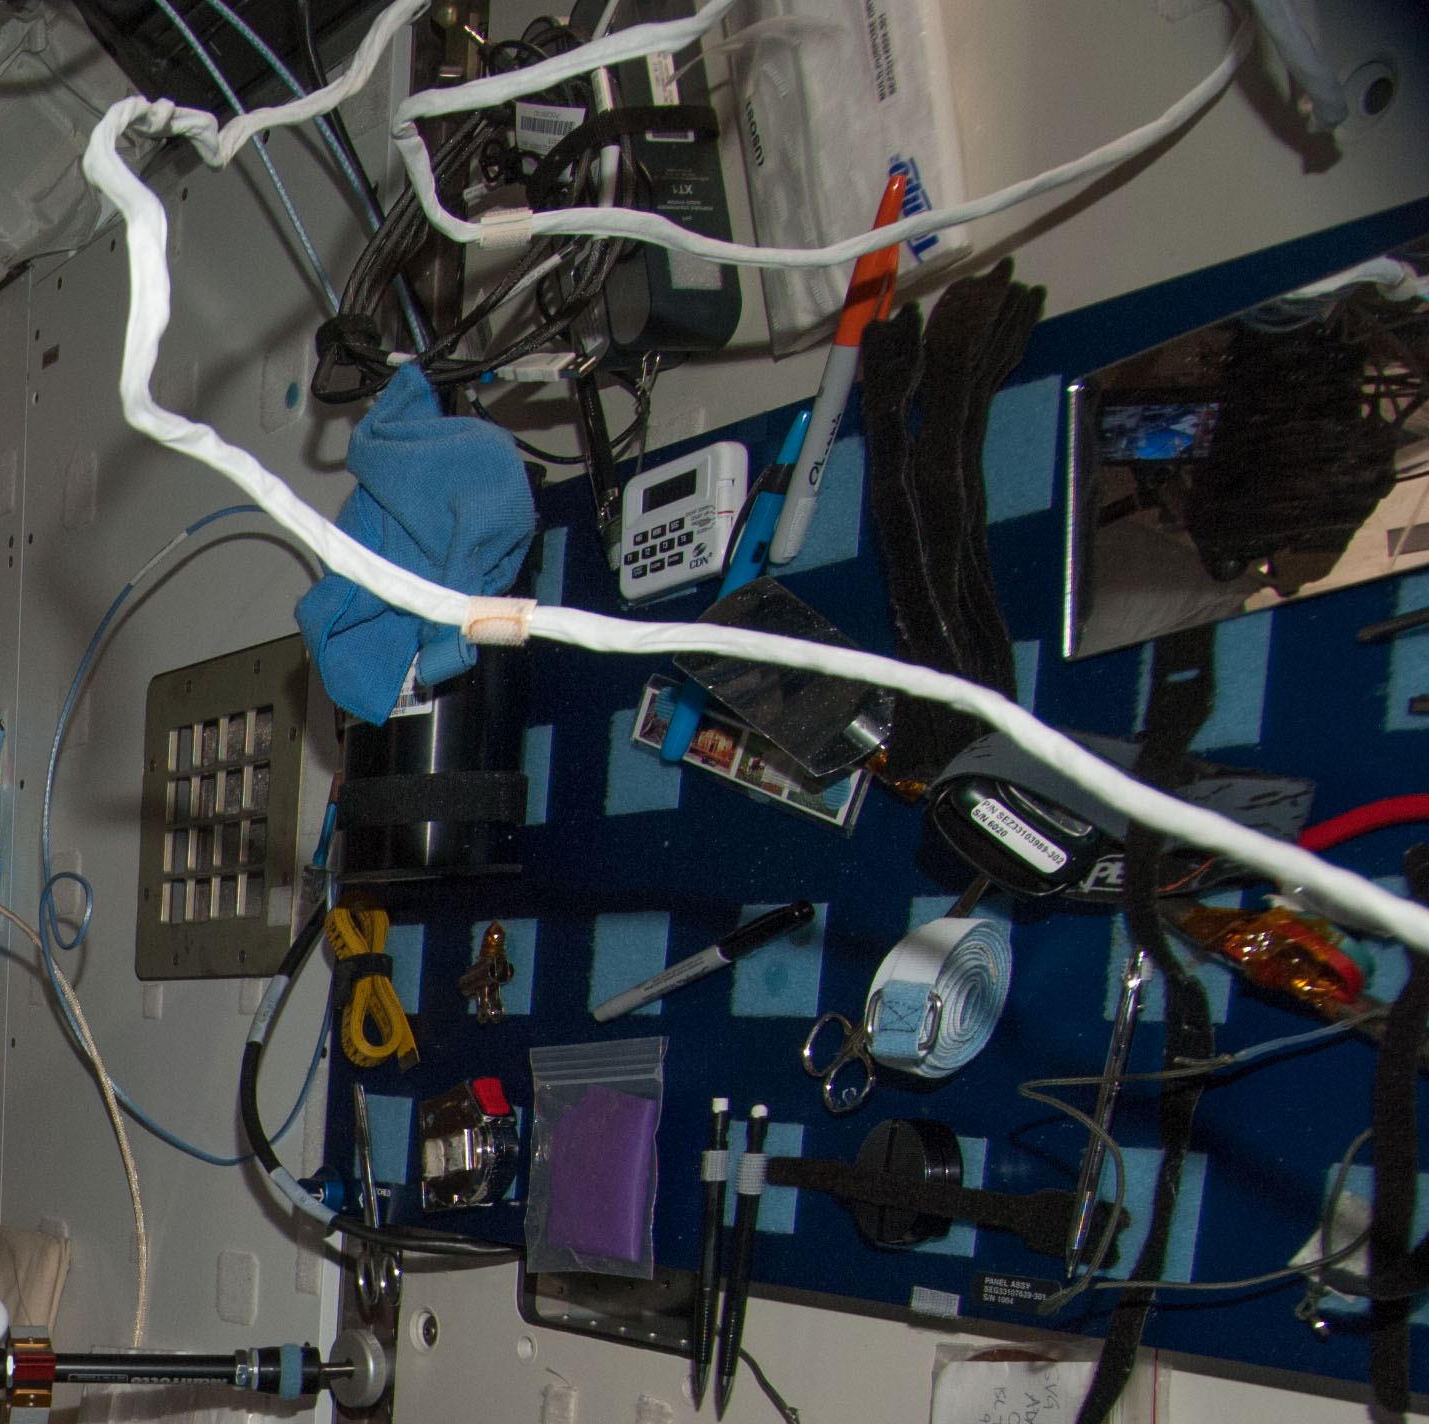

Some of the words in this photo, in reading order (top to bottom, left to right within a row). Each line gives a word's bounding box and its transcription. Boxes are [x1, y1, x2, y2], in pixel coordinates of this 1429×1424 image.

[972, 808, 989, 824] S/N
[987, 819, 1008, 838] 6020
[984, 1276, 1009, 1288] PANEL
[1010, 1279, 1031, 1290] ASSY
